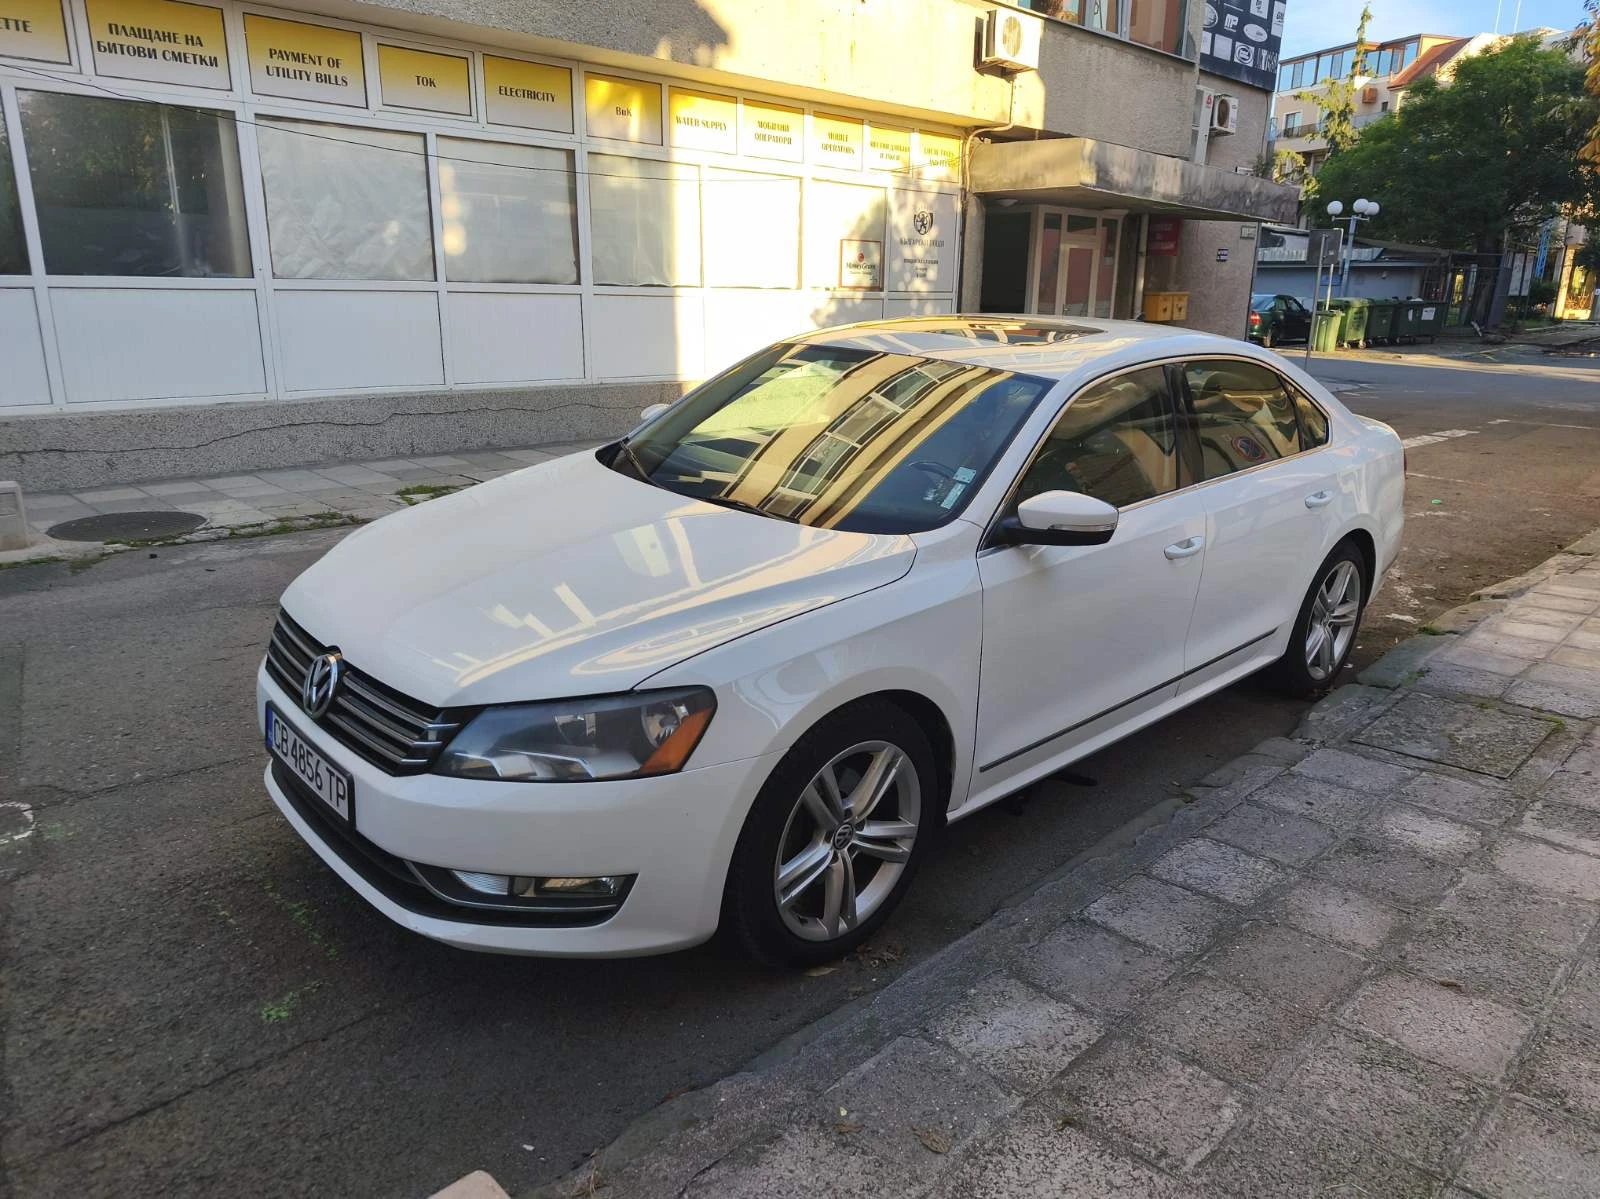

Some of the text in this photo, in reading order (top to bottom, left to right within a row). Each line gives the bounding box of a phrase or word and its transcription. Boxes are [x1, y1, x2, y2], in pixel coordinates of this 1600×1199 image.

[107, 22, 204, 47] ПЛАЩАНЕ НА
[96, 40, 219, 68] БИТОВИ СМЕТКИ
[268, 47, 343, 69] PAYMENT OF
[265, 65, 349, 87] UTILITY BILLS
[498, 85, 556, 102] ELECTRICITY
[675, 115, 728, 131] WATER SUPPLY
[290, 737, 324, 791] 4856
